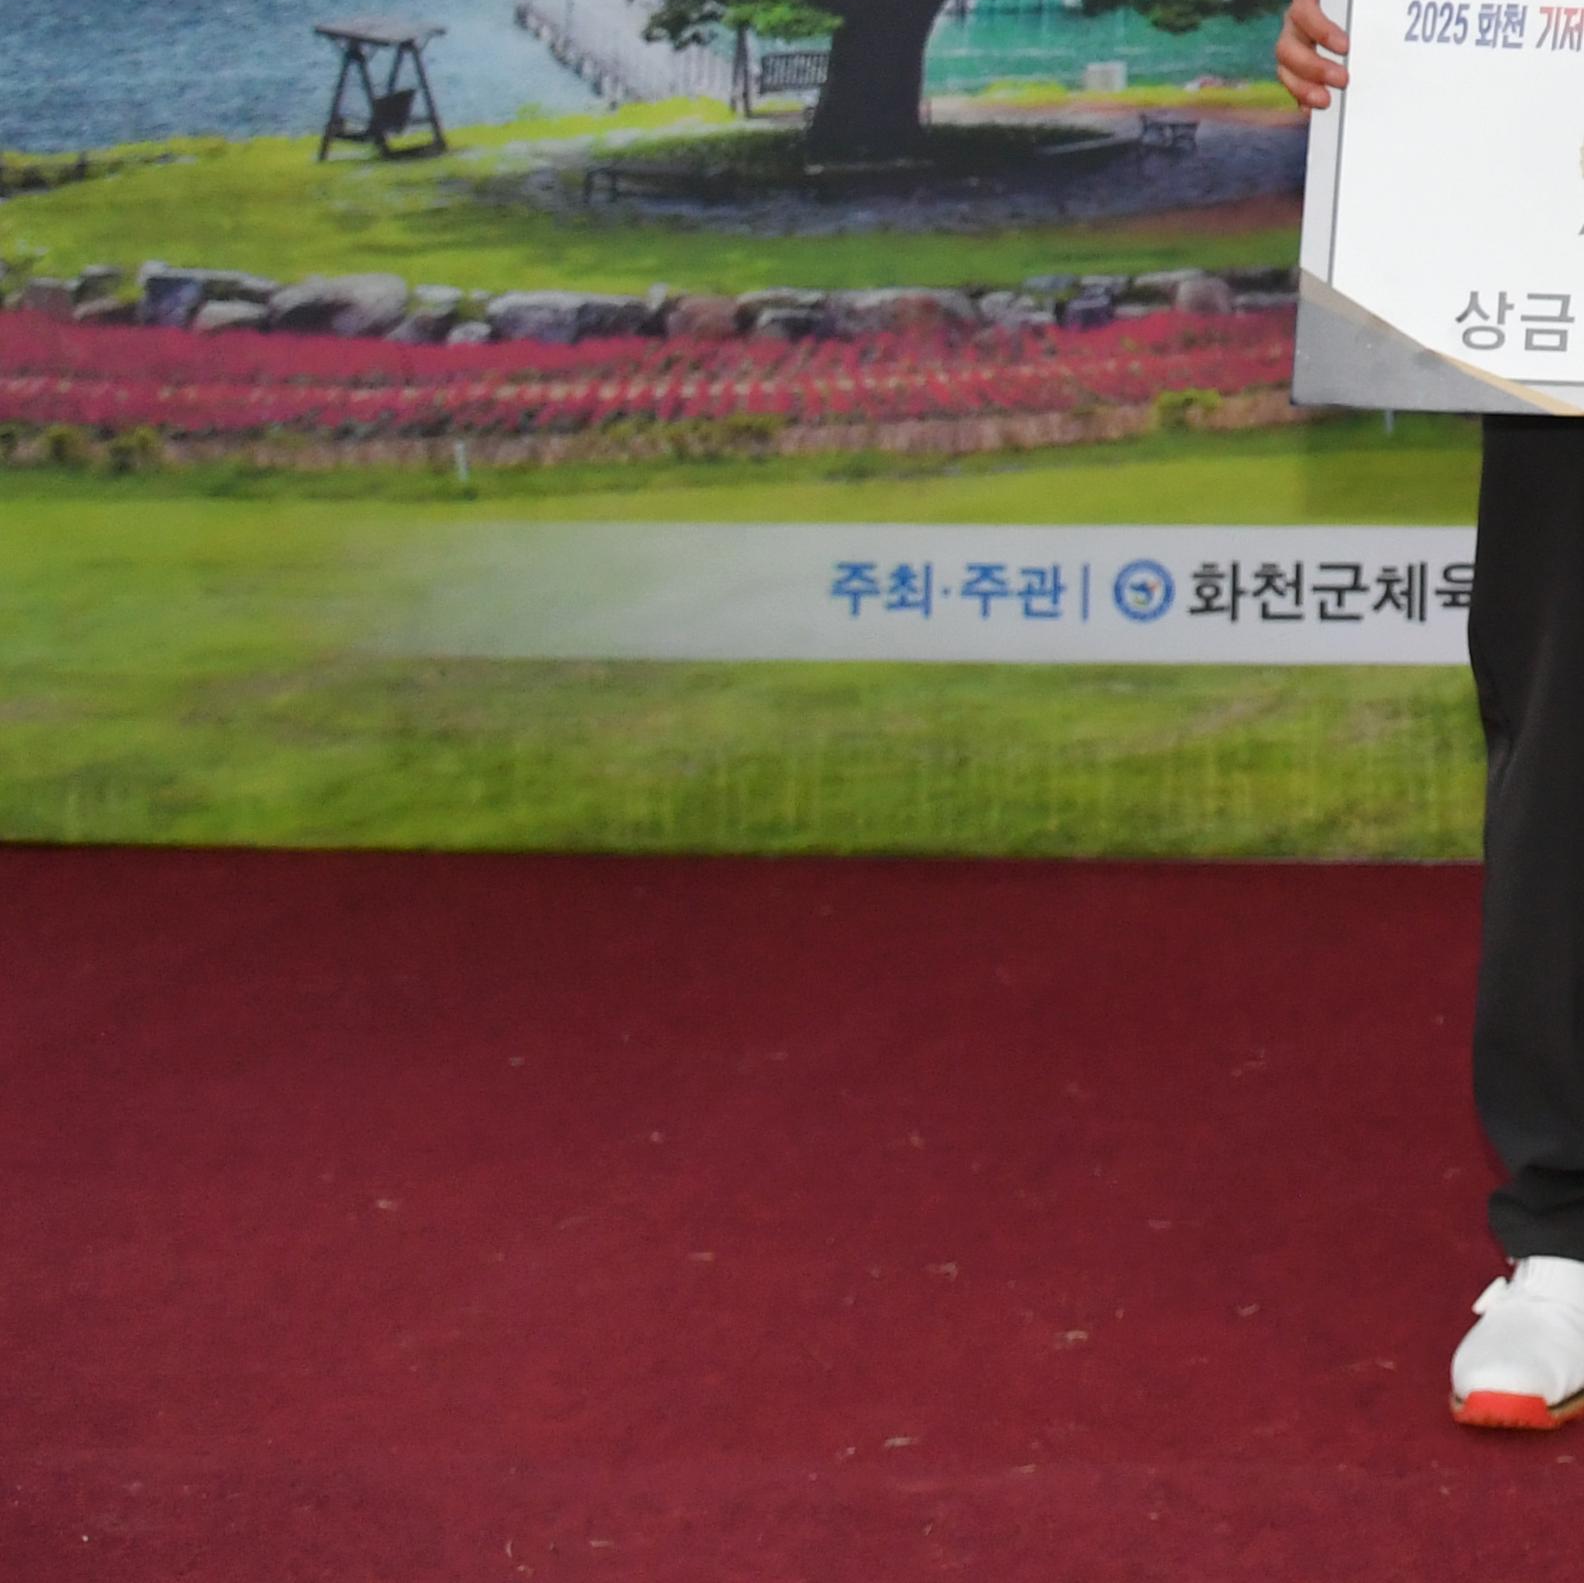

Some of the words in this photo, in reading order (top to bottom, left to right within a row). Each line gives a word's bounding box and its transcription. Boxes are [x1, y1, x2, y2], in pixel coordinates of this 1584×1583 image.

[1403, 0, 1470, 45] 2025
[1475, 2, 1528, 49] 화천
[1454, 290, 1575, 353] 상금
